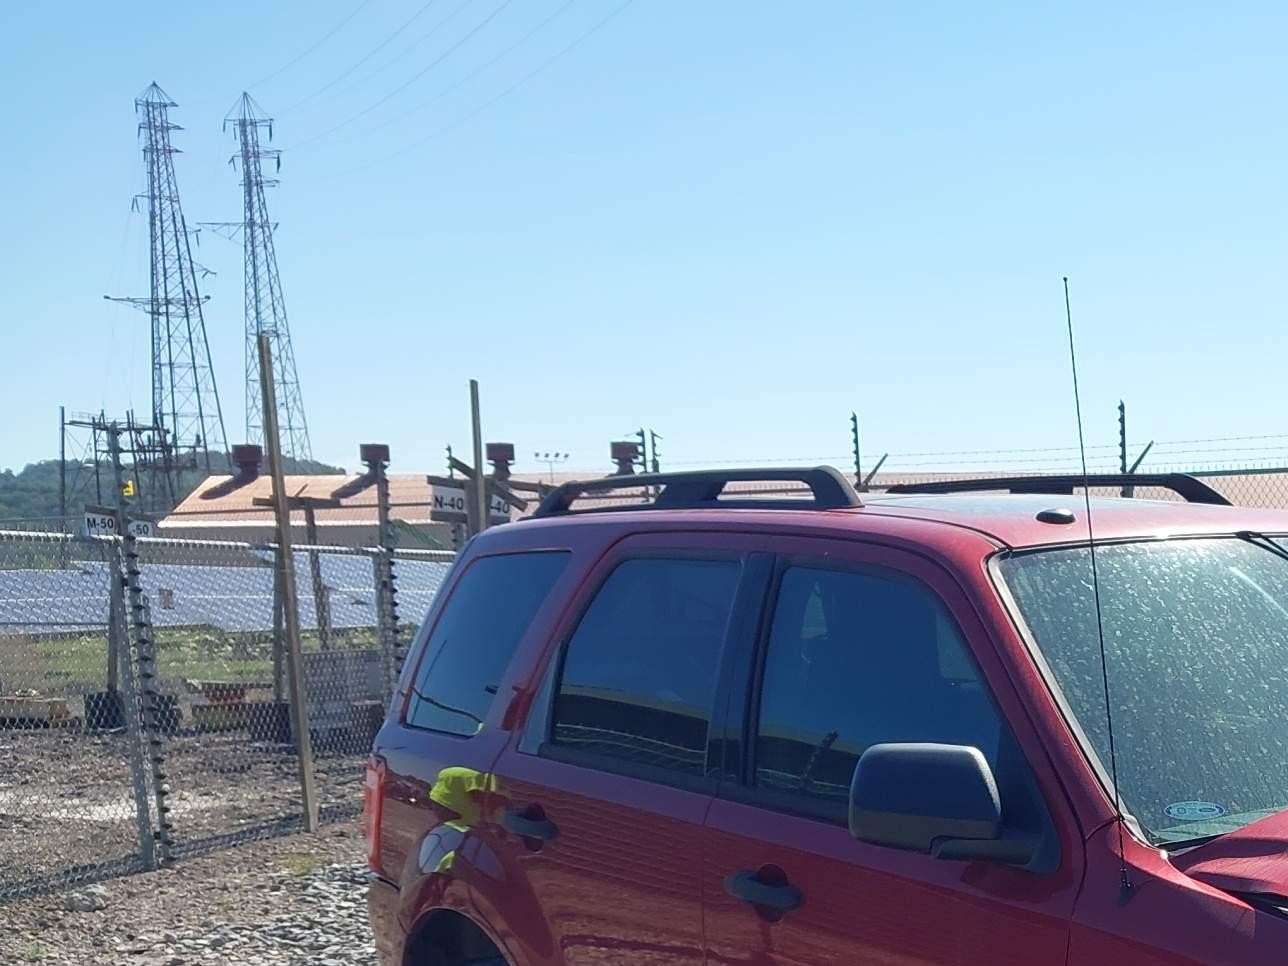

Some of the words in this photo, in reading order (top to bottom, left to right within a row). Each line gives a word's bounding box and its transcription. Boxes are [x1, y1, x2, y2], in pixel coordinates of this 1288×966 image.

[434, 496, 464, 510] N-40
[490, 500, 510, 513] -40
[87, 518, 114, 529] M-50
[132, 524, 149, 535] -50
